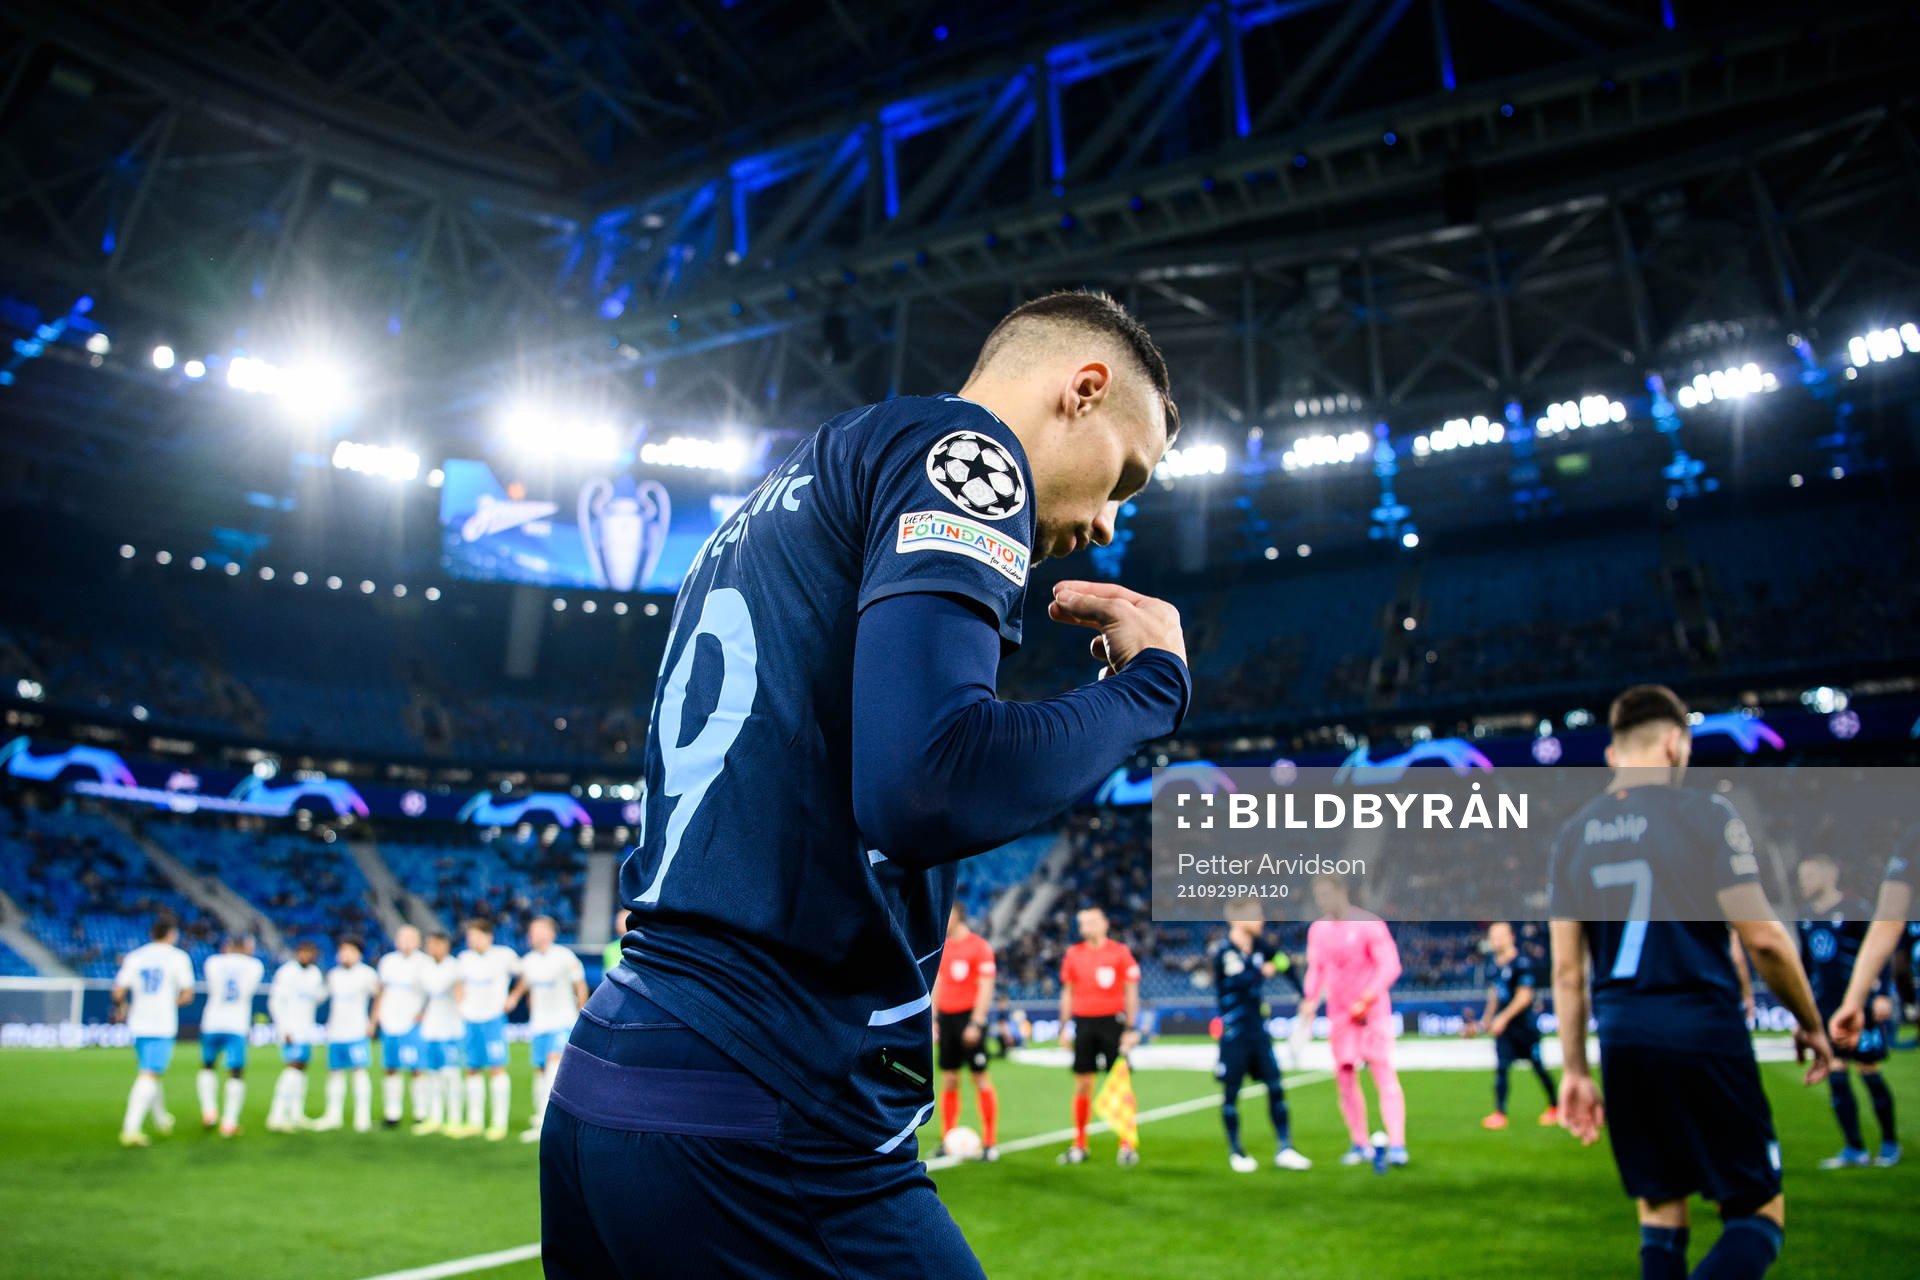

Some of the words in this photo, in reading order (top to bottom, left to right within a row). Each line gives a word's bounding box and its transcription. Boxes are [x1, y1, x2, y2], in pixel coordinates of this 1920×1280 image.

[904, 513, 933, 524] UEFA
[902, 522, 1025, 571] FOUNDATION
[1591, 859, 1653, 980] 7
